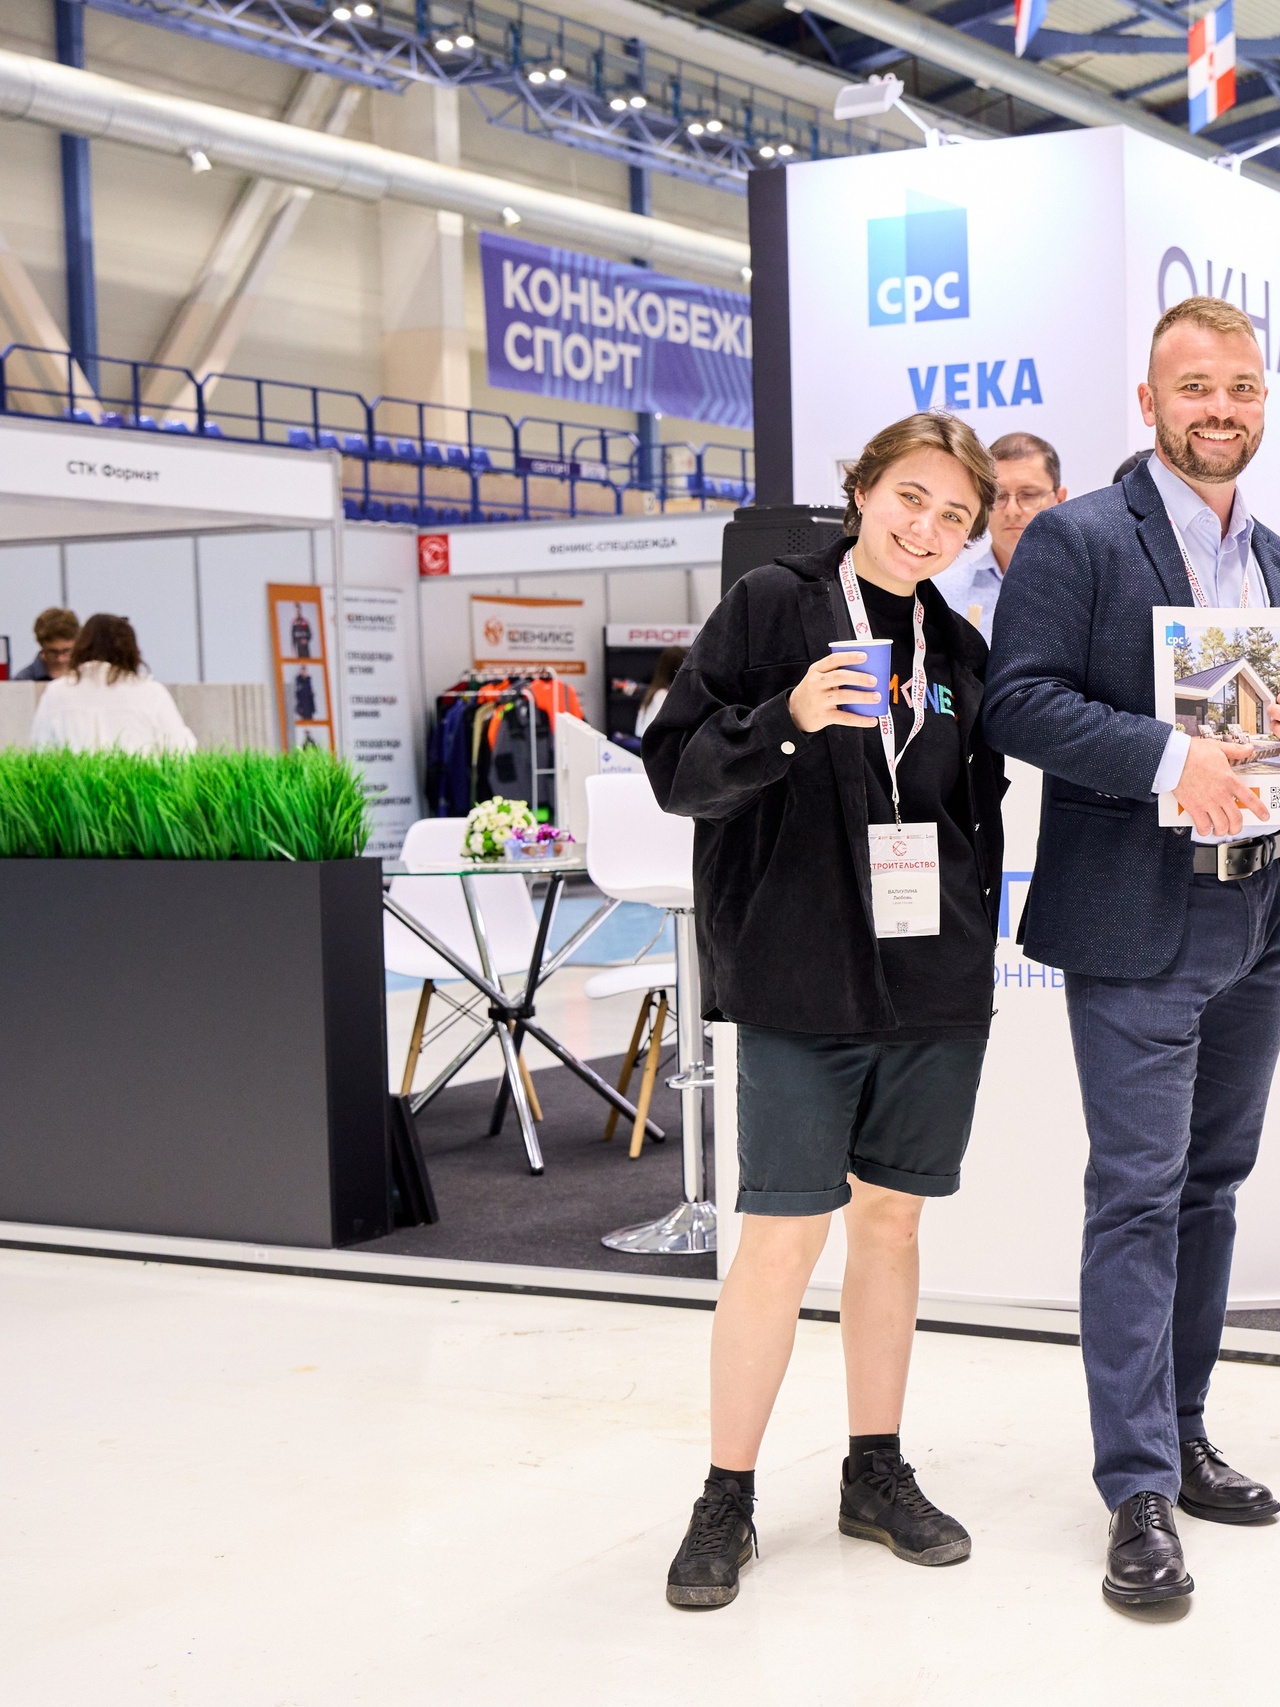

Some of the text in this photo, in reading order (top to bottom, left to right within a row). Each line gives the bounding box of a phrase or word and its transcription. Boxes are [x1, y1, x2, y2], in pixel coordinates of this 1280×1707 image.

[503, 321, 642, 389] СПОРТ
[908, 358, 1043, 411] VEKA
[870, 861, 936, 870] ТРОИТЕЛЬСТВО
